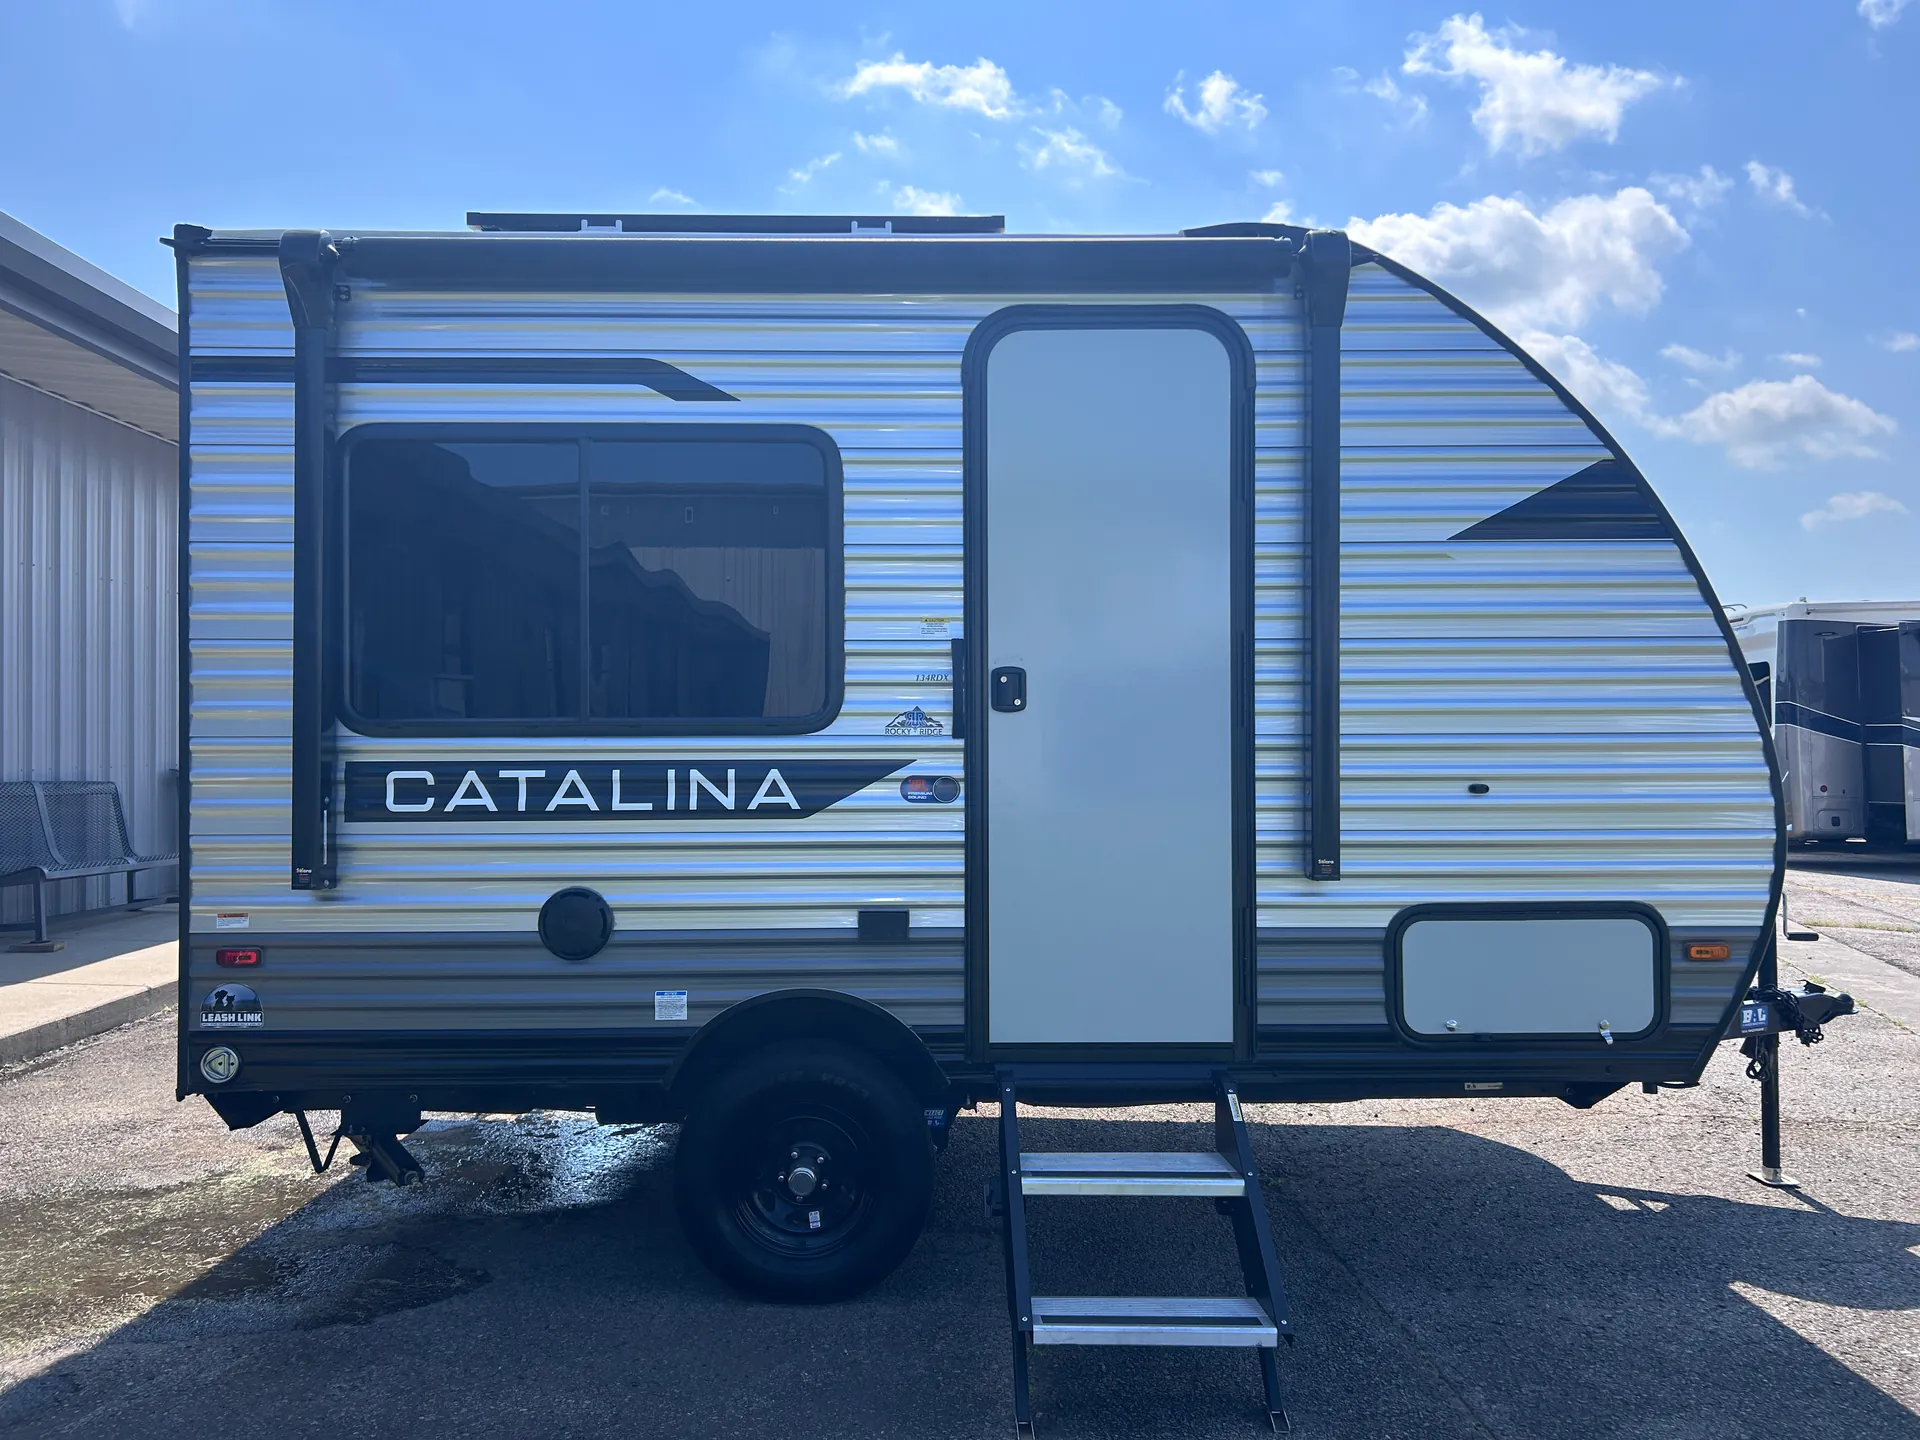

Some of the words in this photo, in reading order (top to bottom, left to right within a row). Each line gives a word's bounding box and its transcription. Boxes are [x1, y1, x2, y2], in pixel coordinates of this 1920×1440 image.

[915, 673, 949, 681] 134RDX
[385, 768, 801, 813] CATALINA
[202, 1013, 236, 1022] LEASH
[237, 1013, 262, 1022] LINK
